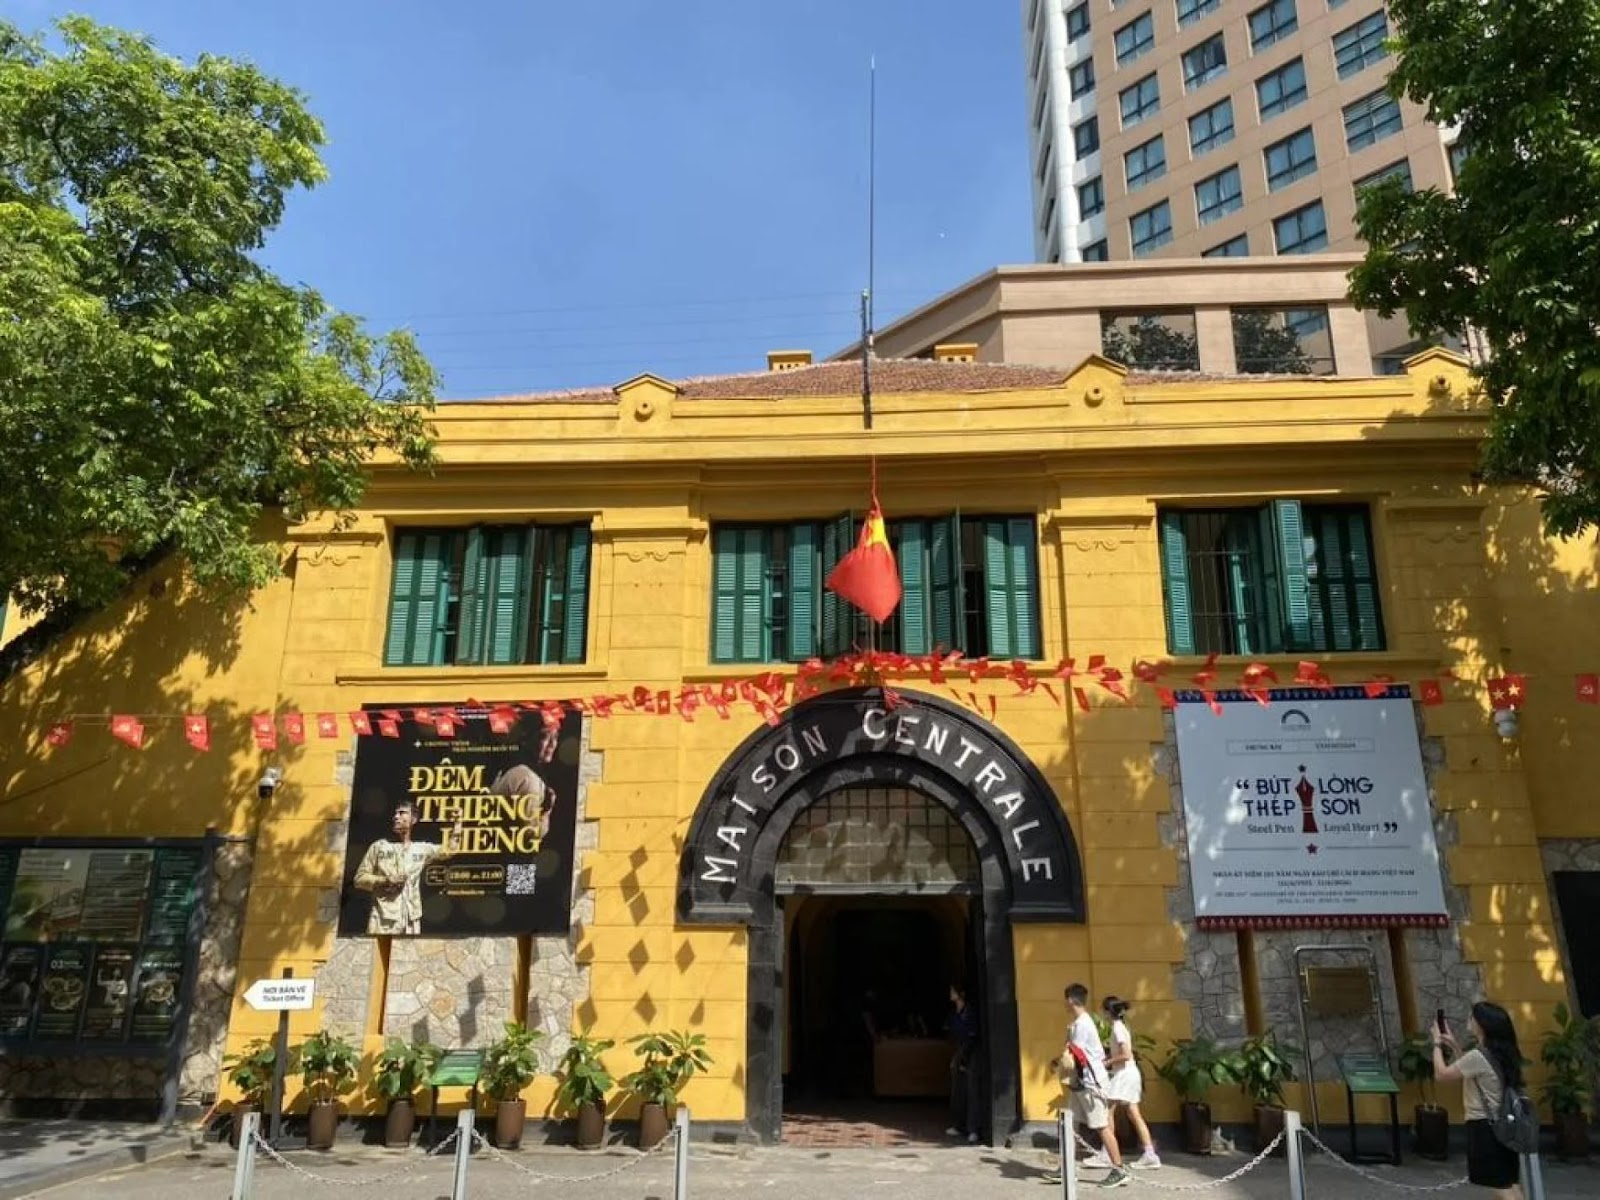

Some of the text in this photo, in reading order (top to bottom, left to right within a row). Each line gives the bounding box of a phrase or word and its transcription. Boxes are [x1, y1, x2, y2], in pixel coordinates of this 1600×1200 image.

[407, 757, 486, 792] ĐÊM
[1256, 774, 1291, 795] BÚT
[1318, 772, 1374, 794] LÒNG
[416, 787, 543, 822] THIÊNG
[701, 708, 1053, 884] MAISON CENTRALE
[1243, 795, 1361, 816] THÉP SON
[439, 820, 541, 854] LIÊNG
[1275, 824, 1295, 834] Pen
